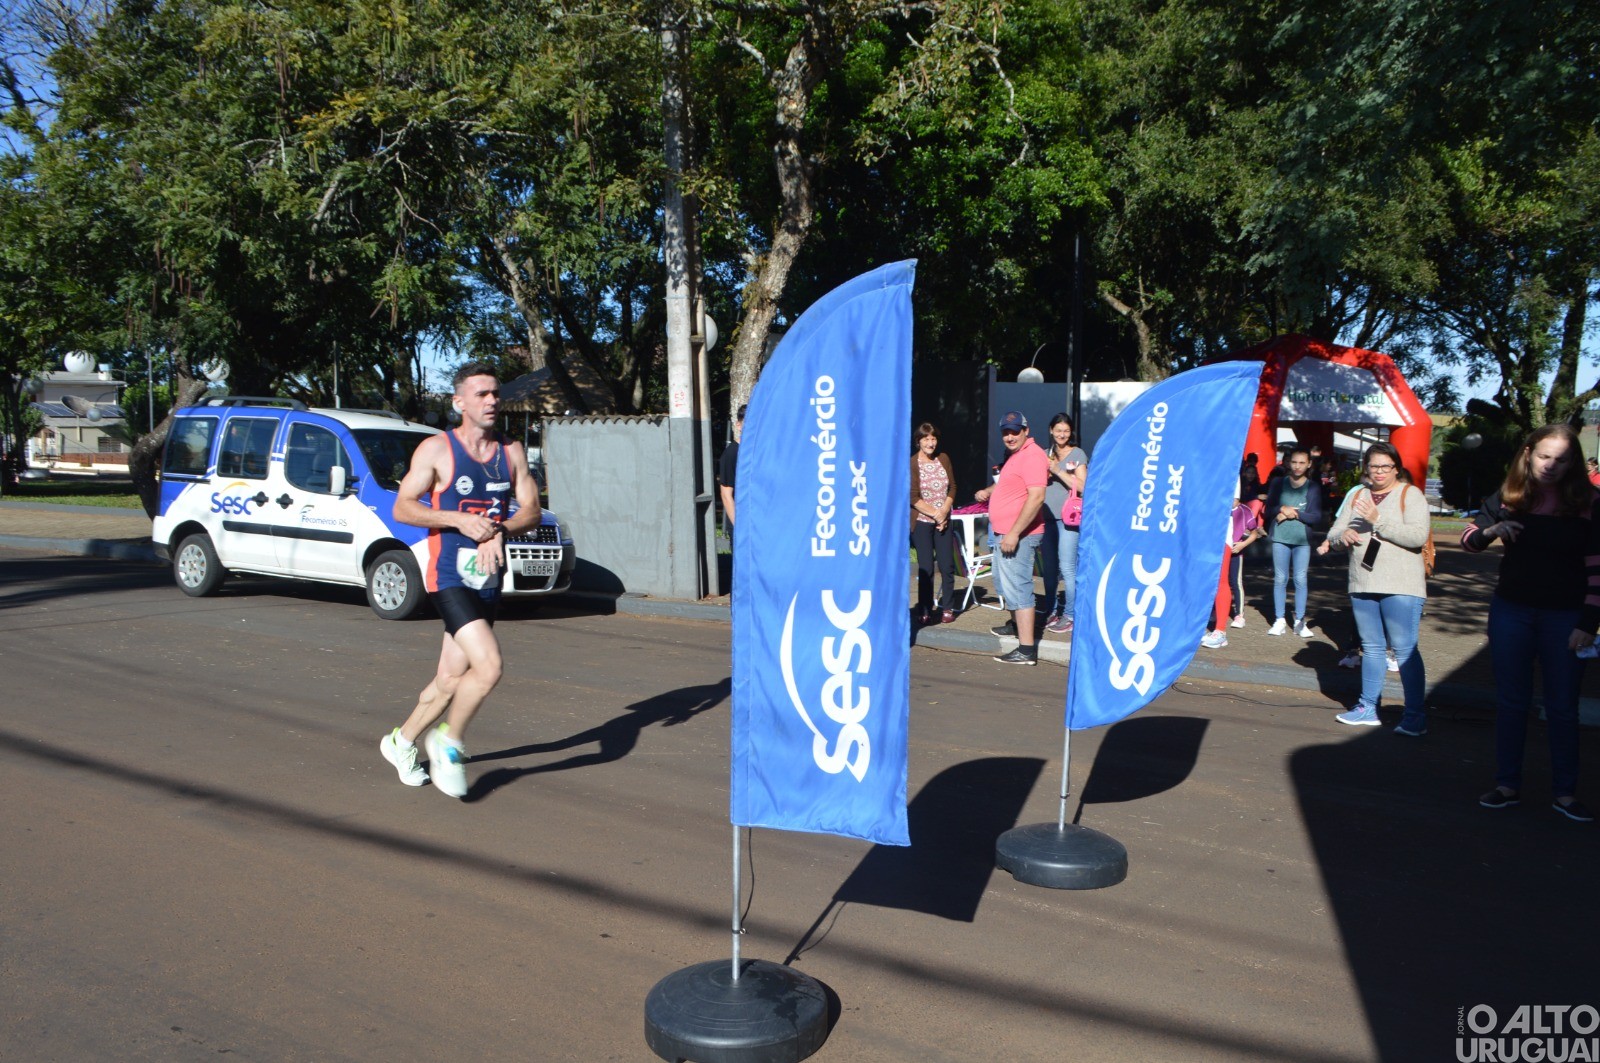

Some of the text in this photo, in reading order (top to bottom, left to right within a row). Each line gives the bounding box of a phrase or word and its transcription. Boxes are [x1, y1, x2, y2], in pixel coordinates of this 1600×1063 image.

[1288, 388, 1385, 405] Horto Florestal
[810, 375, 836, 557] Fecomércio
[849, 461, 871, 557] Senac
[1130, 401, 1169, 532] Fecomércio
[1159, 464, 1185, 534] Senac
